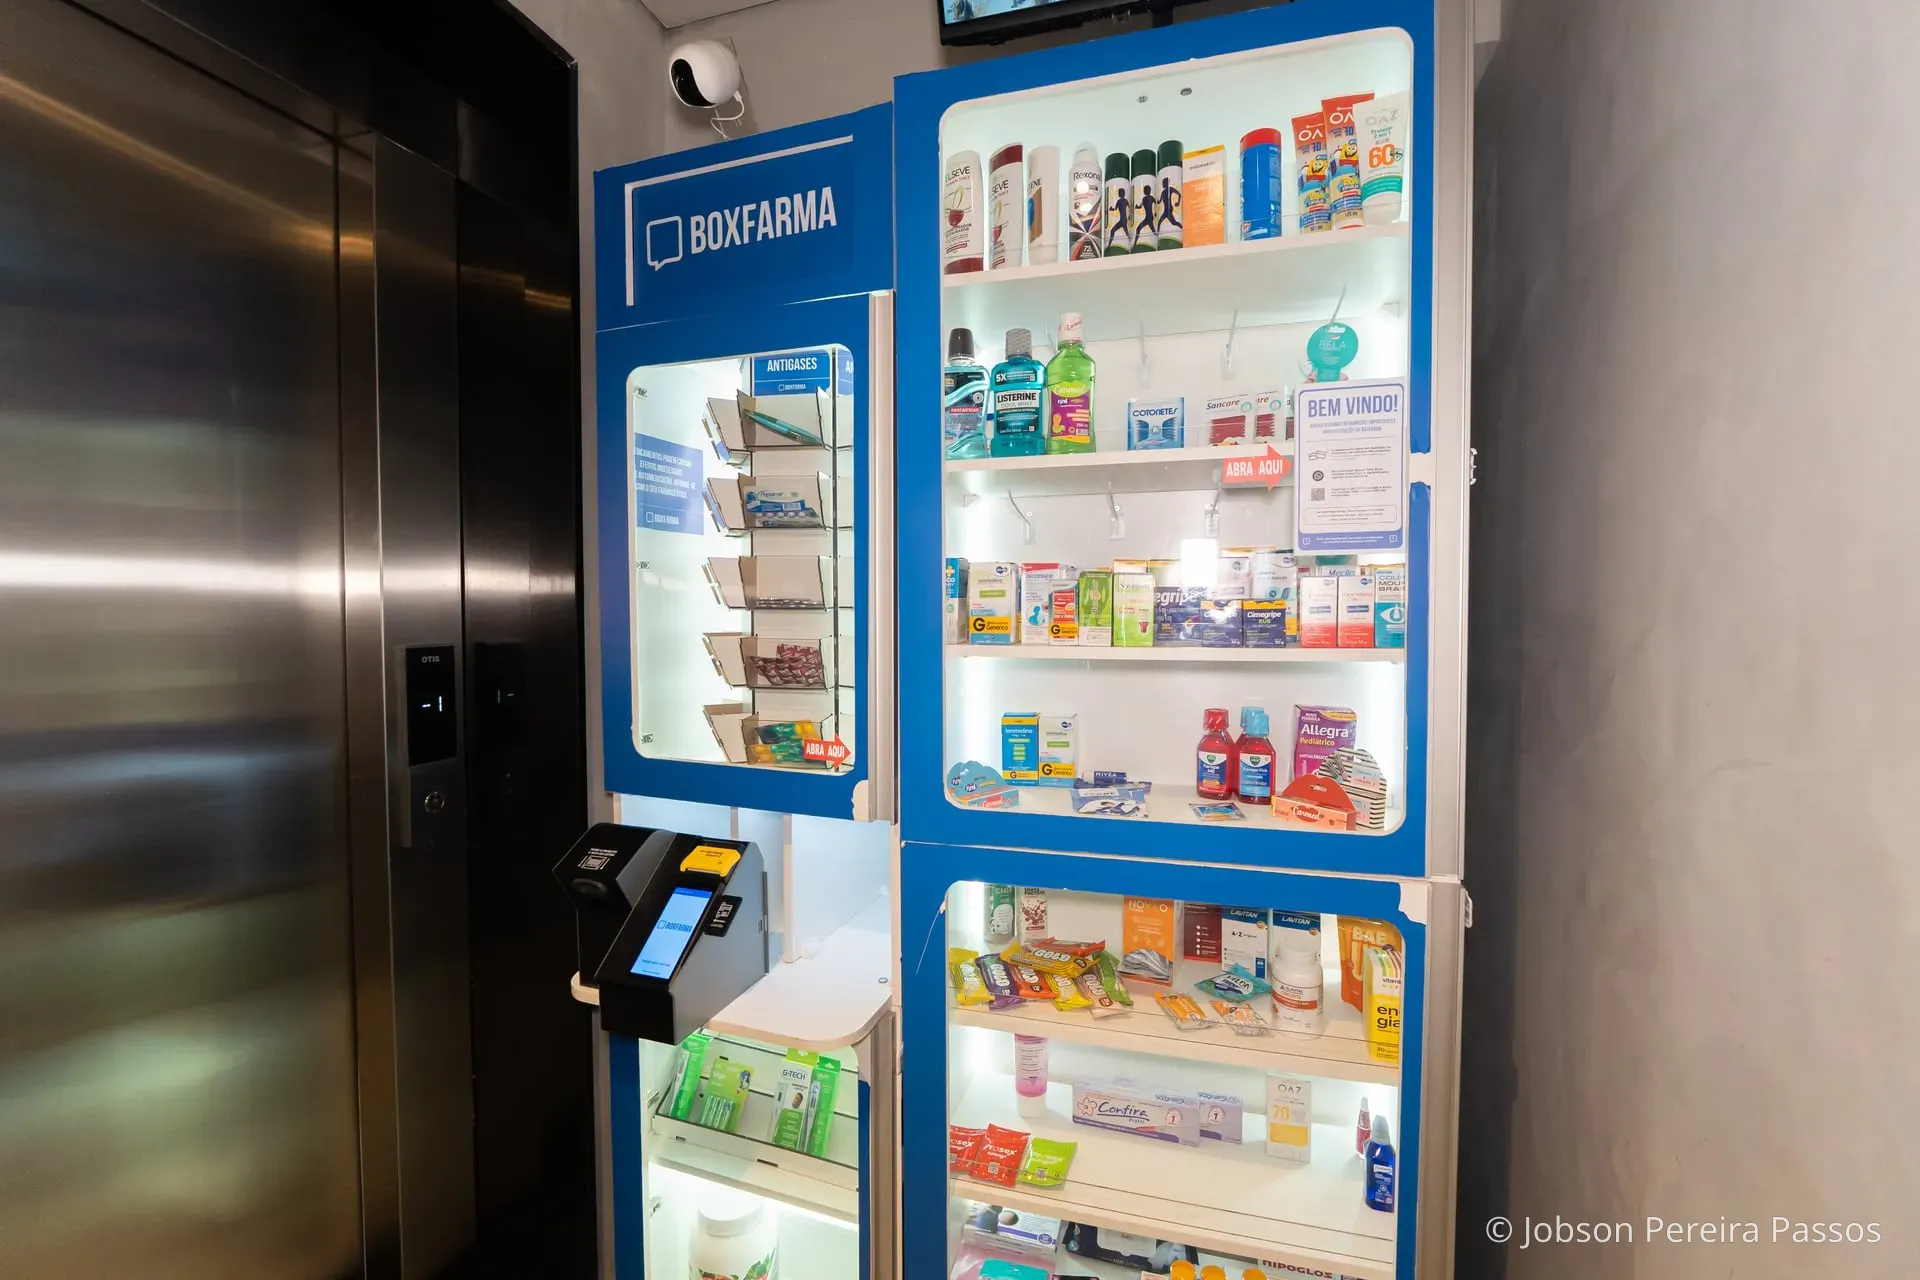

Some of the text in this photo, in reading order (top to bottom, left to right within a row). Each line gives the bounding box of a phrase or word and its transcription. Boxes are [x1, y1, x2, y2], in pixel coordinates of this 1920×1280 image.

[1368, 143, 1395, 168] 60
[690, 186, 837, 254] BOXFARMA
[767, 357, 818, 372] ANTIGASES
[997, 392, 1037, 403] LISTERINE
[1206, 399, 1240, 410] Sancare
[1308, 394, 1398, 418] BEM VINDO!
[1226, 459, 1283, 477] ABRA AQUI
[973, 617, 986, 632] G
[1051, 624, 1060, 635] G
[421, 655, 440, 663] OTIS
[1301, 723, 1349, 738] Allegra
[1300, 737, 1335, 746] Pediátrico
[806, 742, 845, 758] ABRA AQUI
[1042, 763, 1053, 775] G
[1230, 909, 1258, 918] LAVITAN
[1281, 915, 1311, 925] LAVITAN
[1377, 1006, 1400, 1016] en
[782, 1069, 806, 1080] G-TECH
[1097, 1102, 1149, 1117] Confira
